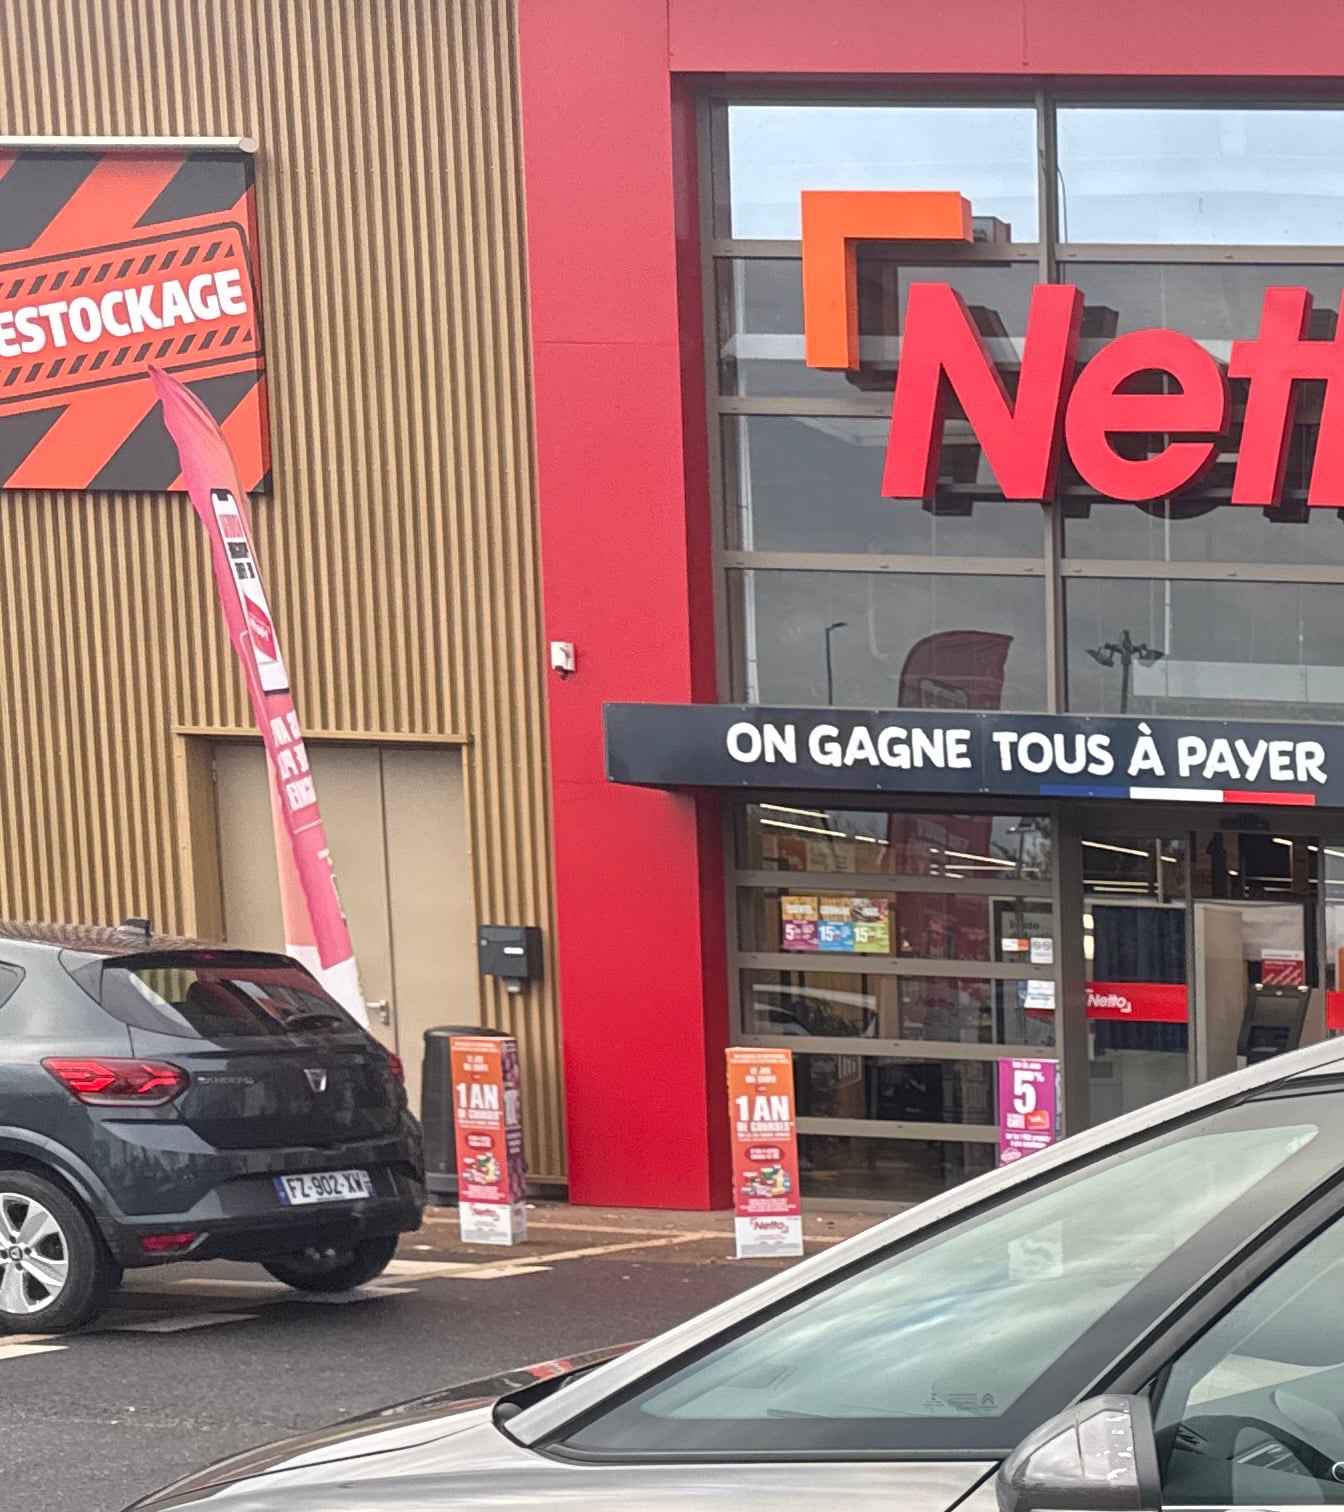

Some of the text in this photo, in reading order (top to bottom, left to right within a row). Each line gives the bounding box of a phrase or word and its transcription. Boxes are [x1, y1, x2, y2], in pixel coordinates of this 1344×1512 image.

[0, 268, 247, 358] ESTOCKAGE
[726, 722, 797, 764] ON
[808, 723, 972, 769] GAGNE
[992, 731, 1115, 776] TOUS
[1128, 722, 1165, 777] À
[1177, 736, 1328, 784] PAYER
[1087, 993, 1127, 1008] Netto
[456, 1083, 499, 1110] 1 AN
[736, 1095, 790, 1121] 1 AN
